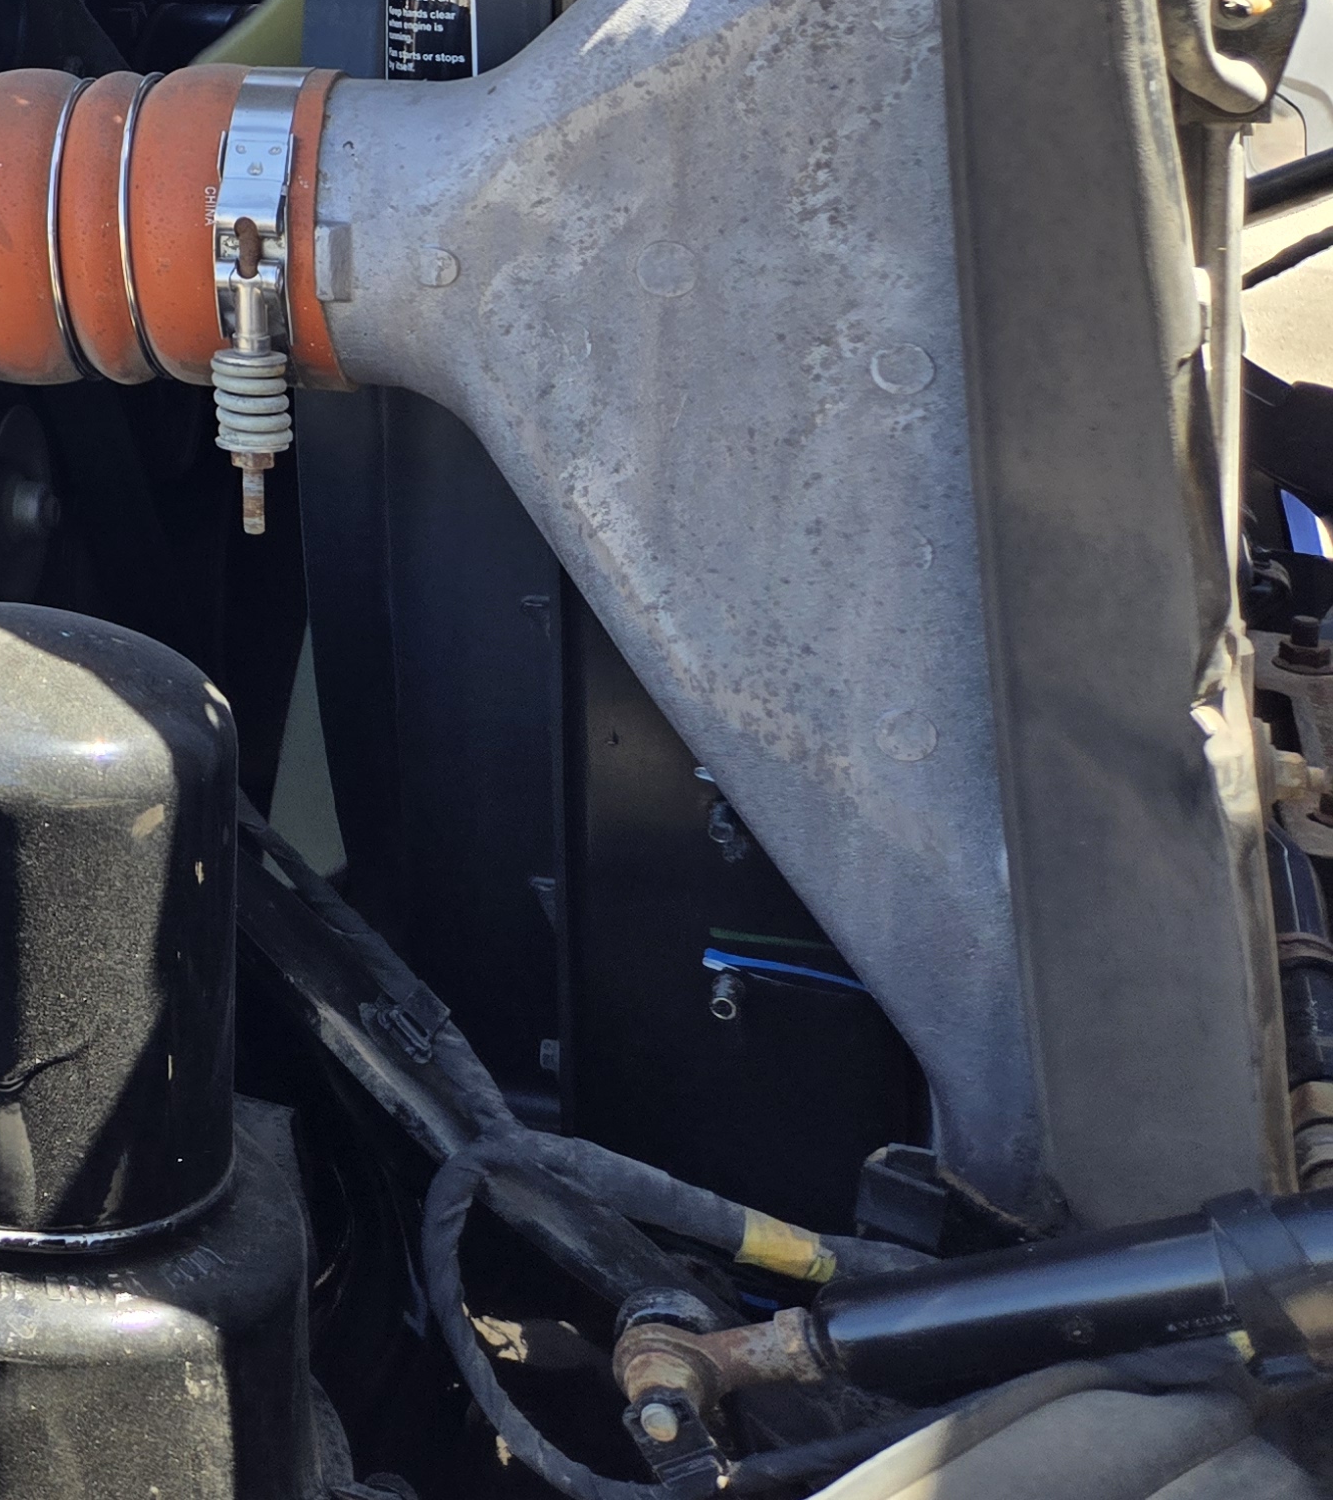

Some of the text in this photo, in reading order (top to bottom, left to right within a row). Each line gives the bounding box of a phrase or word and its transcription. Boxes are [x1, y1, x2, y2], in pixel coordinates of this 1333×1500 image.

[403, 8, 427, 18] hands
[429, 10, 456, 20] clear
[403, 22, 432, 32] engine
[434, 22, 444, 32] is
[399, 50, 421, 60] starts
[423, 53, 433, 61] or
[435, 53, 465, 64] stops
[205, 186, 216, 226] CHINA
